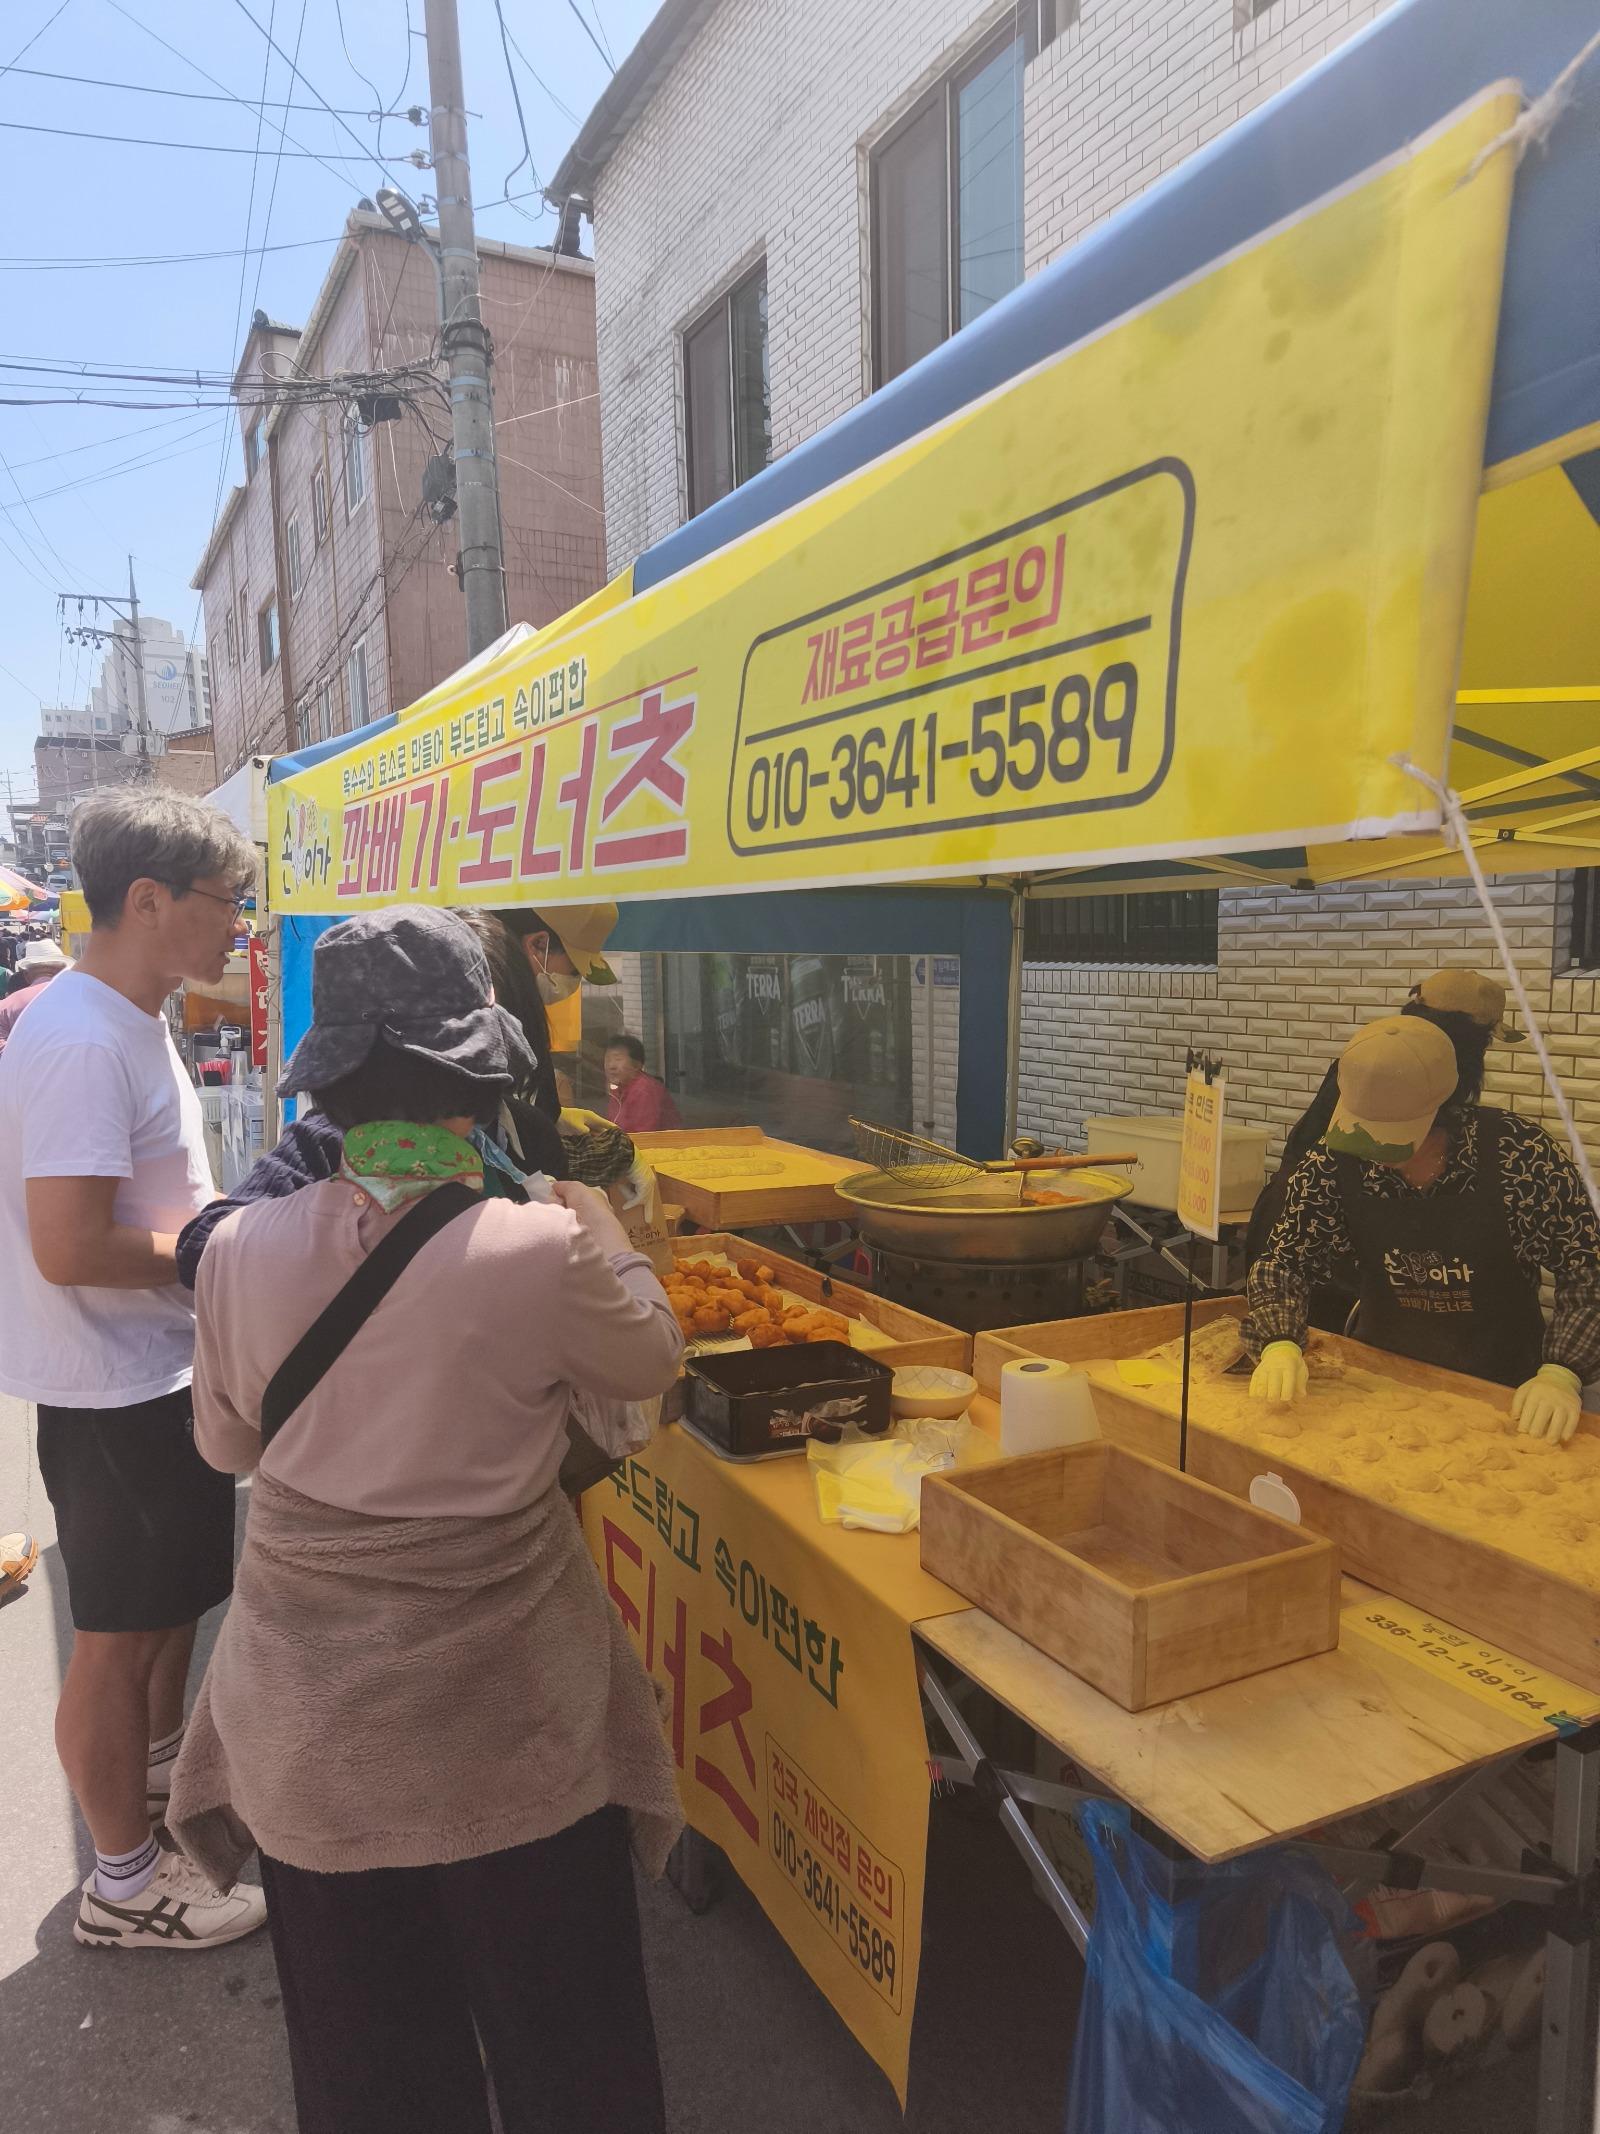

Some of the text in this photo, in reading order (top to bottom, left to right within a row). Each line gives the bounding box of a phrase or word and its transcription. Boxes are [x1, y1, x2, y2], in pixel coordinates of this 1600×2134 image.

[801, 533, 1066, 704] 재료공급문의
[343, 658, 587, 795] 옥수수와 효소로 만들어 부드럽고 속이편한
[746, 661, 1138, 832] 010-3641-5589
[746, 974, 781, 1000] TERRA
[793, 997, 826, 1033] TERRA
[714, 1536, 845, 1711] 속이편한
[1365, 1613, 1549, 1711] 336-12-189164
[772, 1751, 799, 1816] 전국
[857, 1844, 893, 1921] 문의
[773, 1811, 896, 1998] 010-3641-5589
